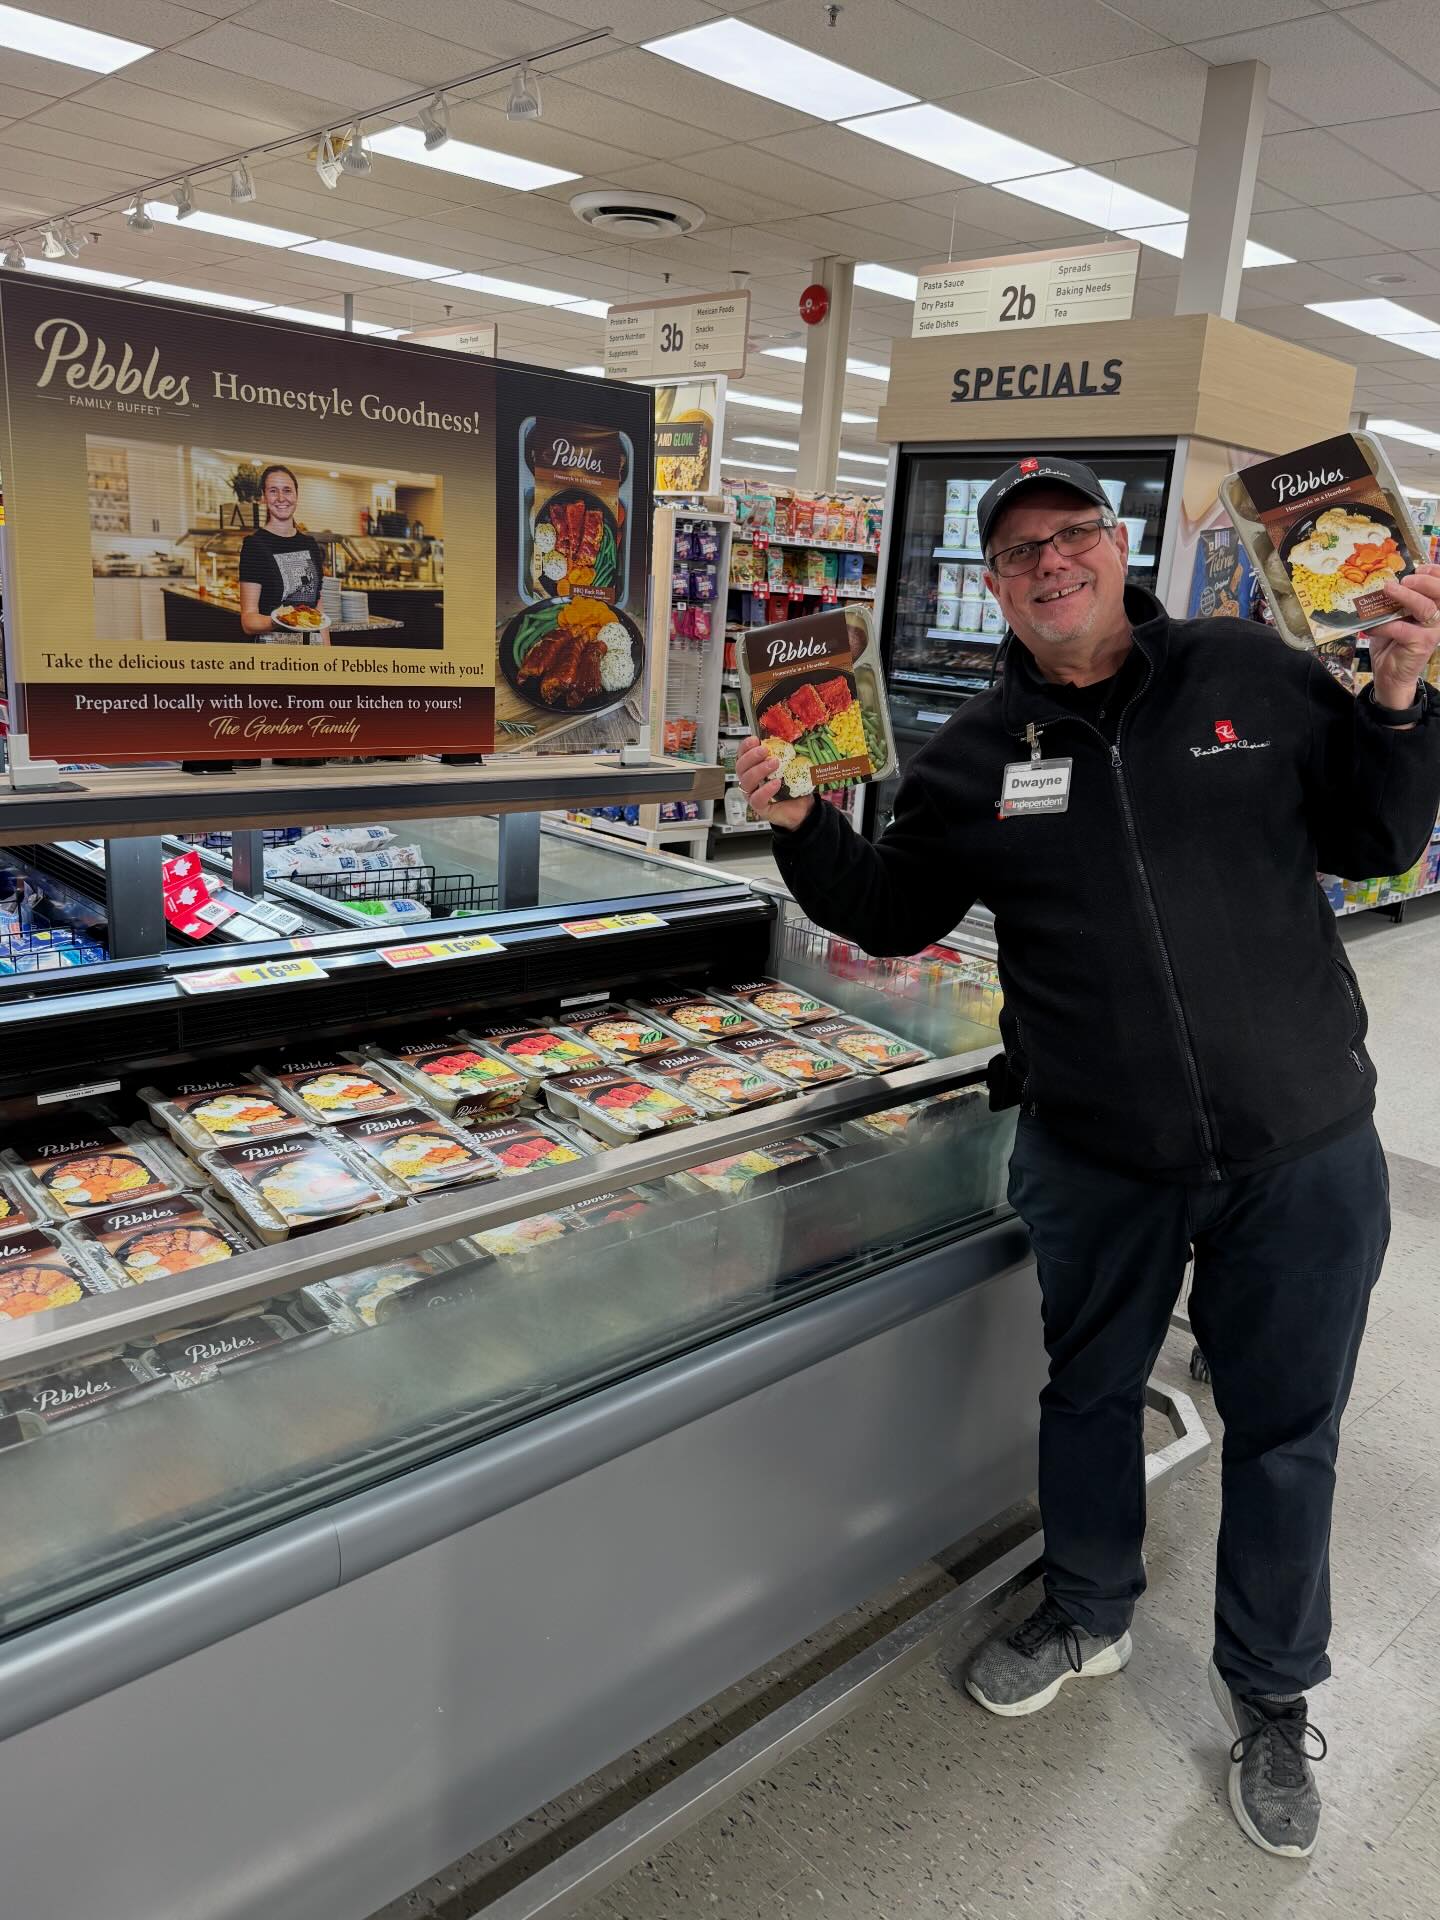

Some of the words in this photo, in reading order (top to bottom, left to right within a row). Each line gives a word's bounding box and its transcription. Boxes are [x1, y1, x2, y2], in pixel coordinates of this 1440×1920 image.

[1058, 263, 1092, 275] Spreads
[923, 281, 942, 290] Pasta
[943, 278, 965, 288] Sauce
[1056, 286, 1084, 297] Baking
[1085, 283, 1112, 293] Needs
[719, 305, 735, 314] Foods
[921, 302, 935, 312] Dry
[935, 300, 954, 310] Pasta
[999, 284, 1036, 322] 2b
[1054, 309, 1068, 318] Tea
[695, 325, 714, 334] Snacks
[919, 321, 934, 331] Side
[935, 319, 959, 330] Dishes
[660, 322, 684, 352] 3b
[694, 343, 709, 351] Chips
[34, 318, 190, 406] Pebbles
[693, 360, 707, 369] Soup
[951, 358, 1123, 401] SPECIALS
[69, 396, 112, 412] FAMILY
[117, 401, 161, 417] BUFFET
[212, 371, 353, 420] Homestyle
[360, 394, 480, 435] Goodness!
[657, 433, 673, 447] AND
[552, 438, 602, 474] Pebbles
[1271, 468, 1344, 503] Pebbles
[1285, 500, 1314, 513] Homestyle
[1324, 487, 1351, 500] Heartbeat
[1358, 592, 1384, 606] Chicken
[766, 637, 828, 668] Pebbles
[42, 653, 83, 669] Take
[89, 653, 113, 669] the
[118, 654, 185, 670] delicious
[191, 656, 225, 670] taste
[229, 657, 255, 671] and
[260, 657, 319, 672] tradition
[324, 658, 338, 672] of
[342, 660, 388, 673] Pebbles
[392, 660, 426, 674] home
[429, 662, 455, 675] with
[459, 664, 485, 678] you!
[75, 694, 148, 714] Prepared
[153, 694, 205, 713] locally
[209, 694, 243, 710] with
[248, 695, 282, 709] love.
[287, 695, 325, 710] From
[329, 699, 353, 709] our
[357, 695, 404, 709] kitchen
[408, 698, 421, 709] to
[425, 697, 462, 713] yours!
[208, 715, 242, 740] The
[244, 715, 303, 742] Gerber
[307, 715, 361, 742] Family
[1011, 775, 1062, 789] Dwayne
[731, 981, 767, 993] Pebbles
[568, 1009, 609, 1022] Pebbles
[811, 1022, 848, 1035] Pebbles
[401, 1040, 448, 1056] Pebbles
[736, 1037, 774, 1050] Pebbles
[283, 1060, 335, 1074] Pebbles
[659, 1053, 701, 1070] Pebbles
[177, 1081, 235, 1095] Pebbles
[570, 1073, 614, 1088] Pebbles
[360, 1118, 416, 1136] Pebbles
[472, 1127, 518, 1143] Pebbles
[38, 1138, 101, 1158] Pebbles
[242, 1143, 304, 1162] Pebbles
[108, 1207, 174, 1231] Pebbles
[185, 1335, 255, 1364] Pebbles
[34, 1380, 112, 1412] Pebbles
